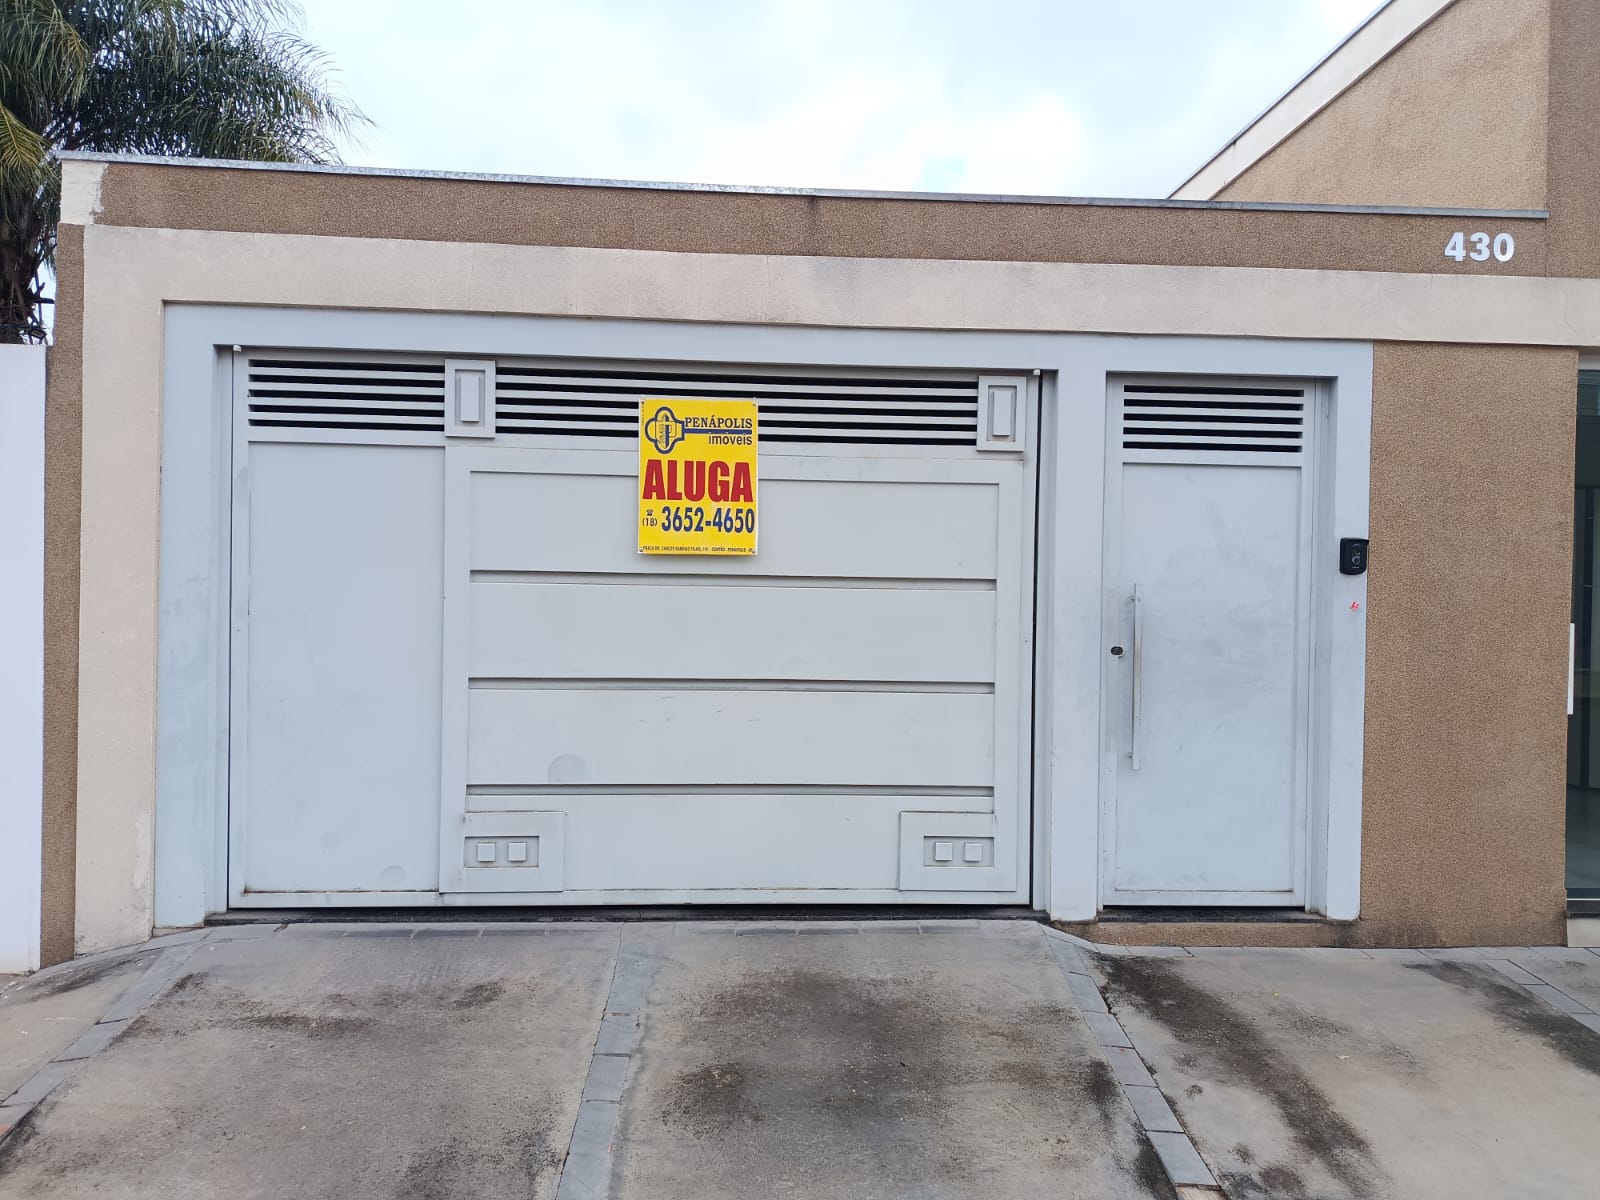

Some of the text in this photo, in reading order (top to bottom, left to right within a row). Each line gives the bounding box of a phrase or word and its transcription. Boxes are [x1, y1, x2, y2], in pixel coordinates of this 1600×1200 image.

[1444, 231, 1515, 262] 430
[684, 414, 753, 429] PENÁPOLIS
[642, 459, 754, 503] ALUGA
[642, 506, 755, 534] (18) 3652-4650
